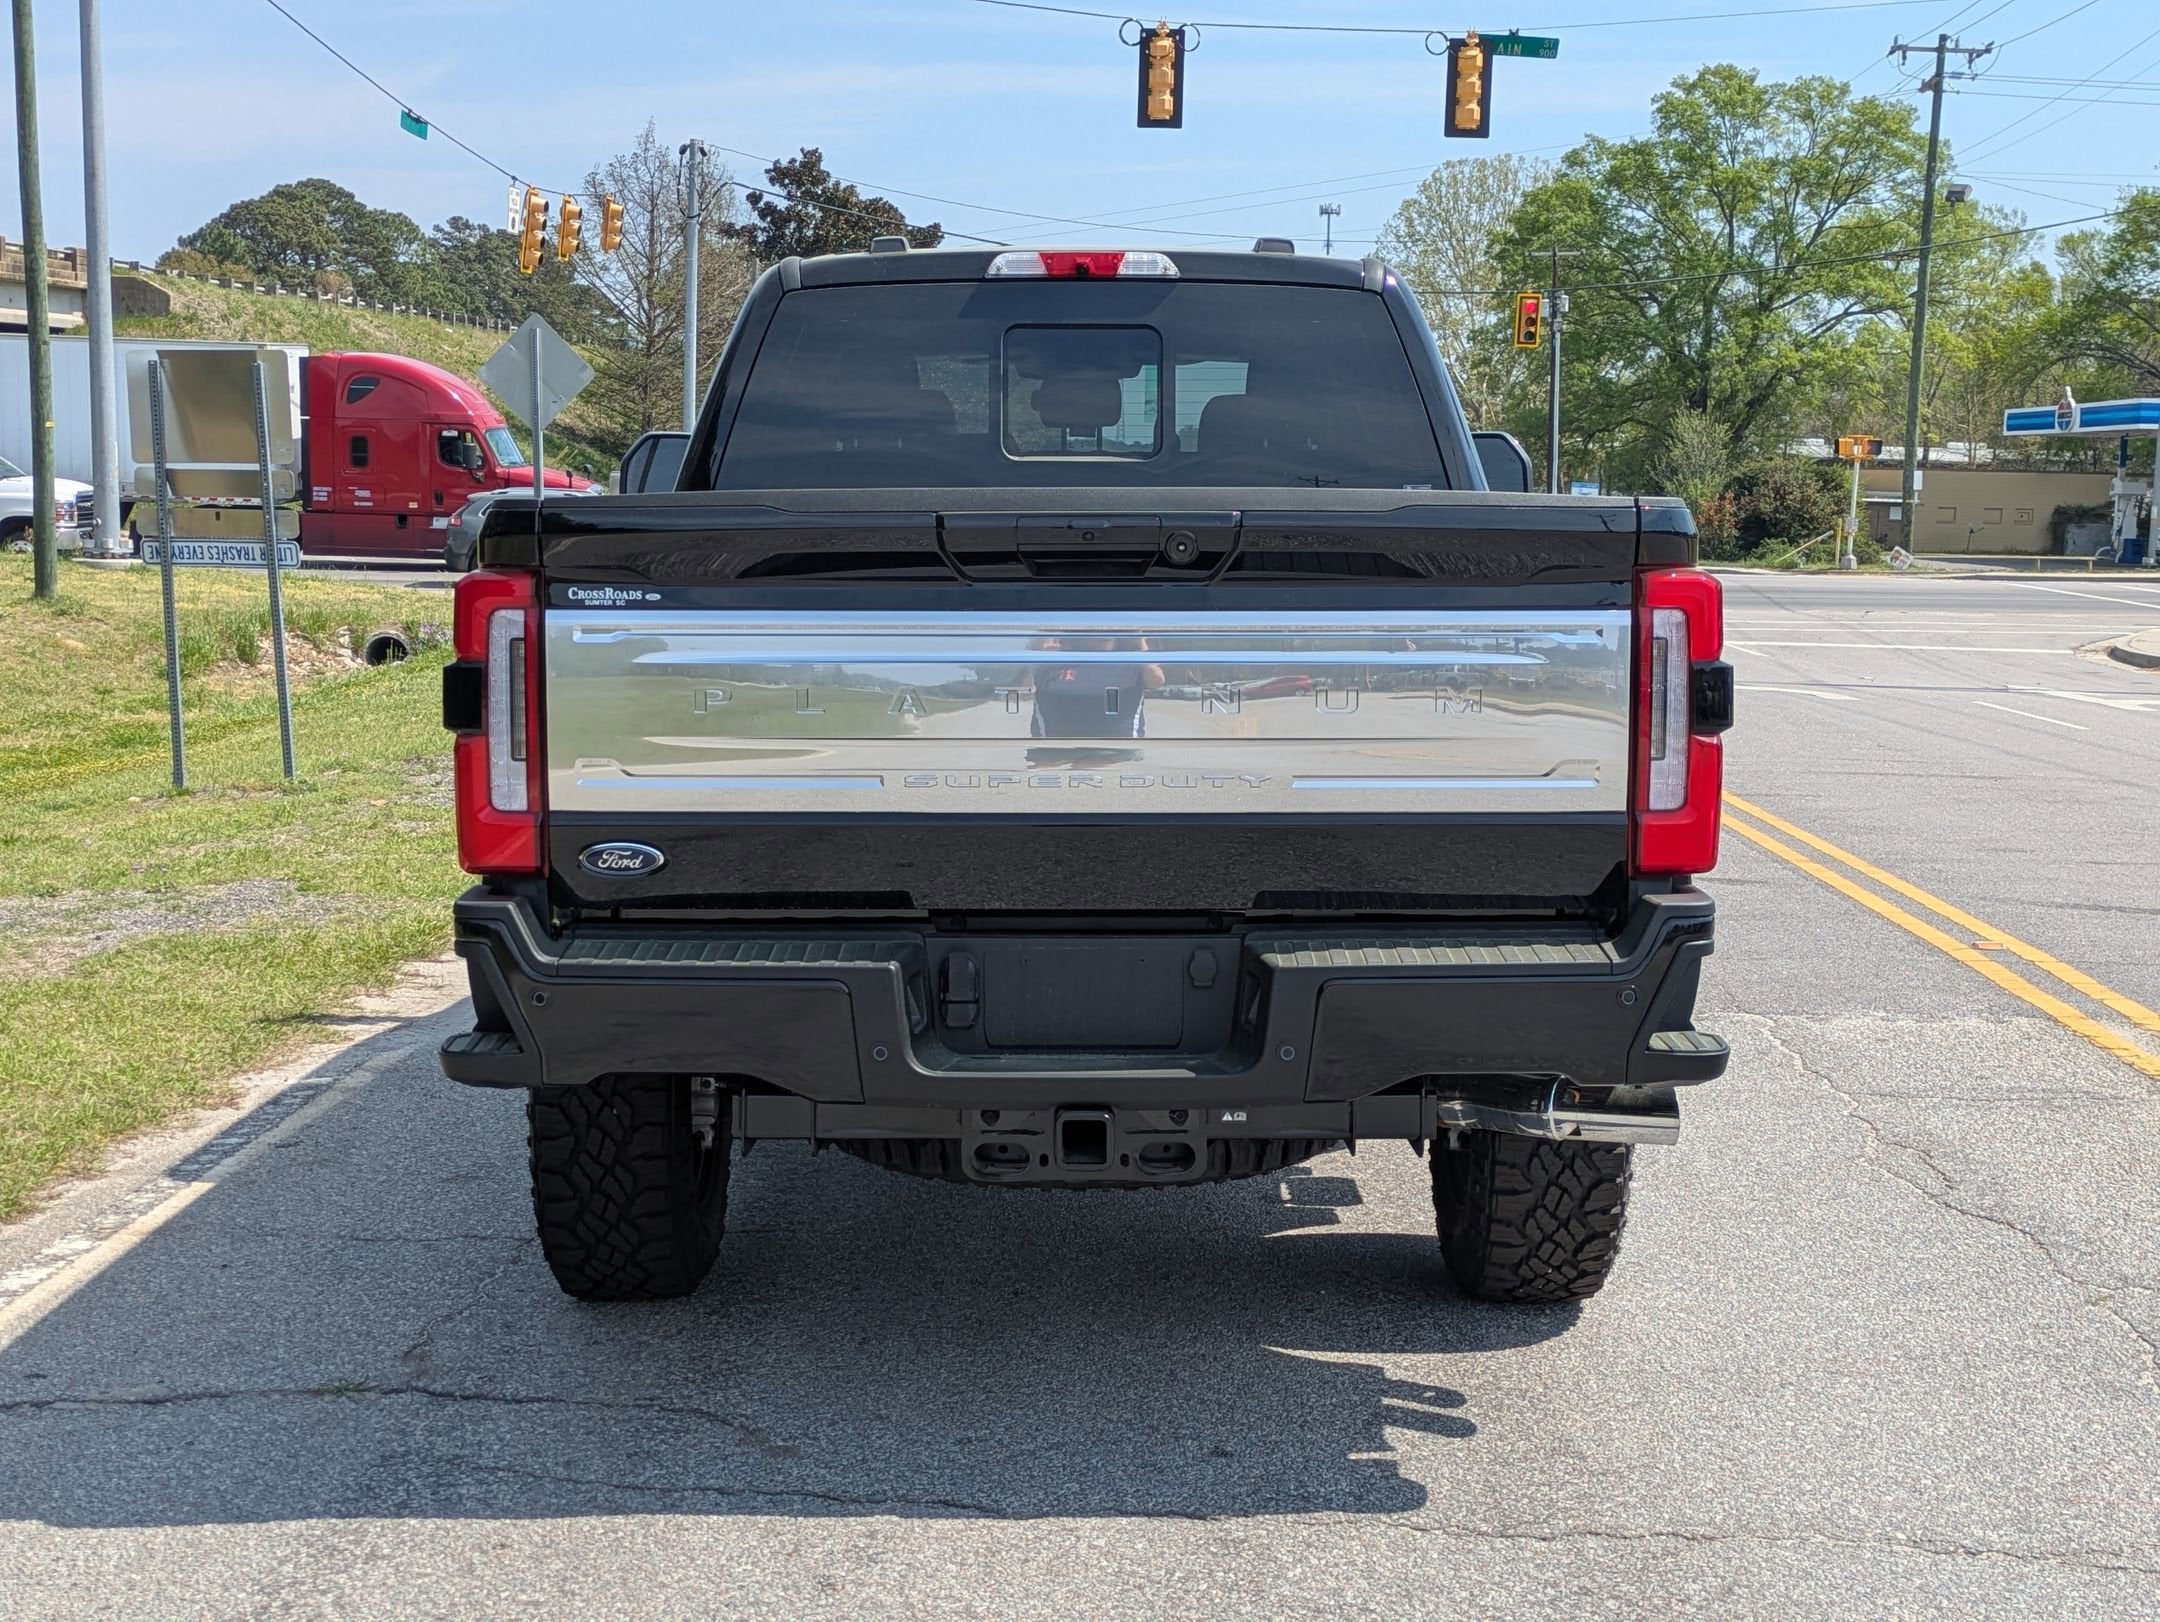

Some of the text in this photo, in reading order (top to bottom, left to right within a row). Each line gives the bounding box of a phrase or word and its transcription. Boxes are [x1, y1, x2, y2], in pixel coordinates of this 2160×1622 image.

[1496, 40, 1555, 55] AIN ST
[1539, 49, 1556, 58] 900
[148, 544, 293, 561] LITR TRASHES EVERYNE
[693, 687, 1483, 715] PLATINUM
[903, 773, 1273, 788] SUPER DUTY
[598, 850, 643, 869] Ford
